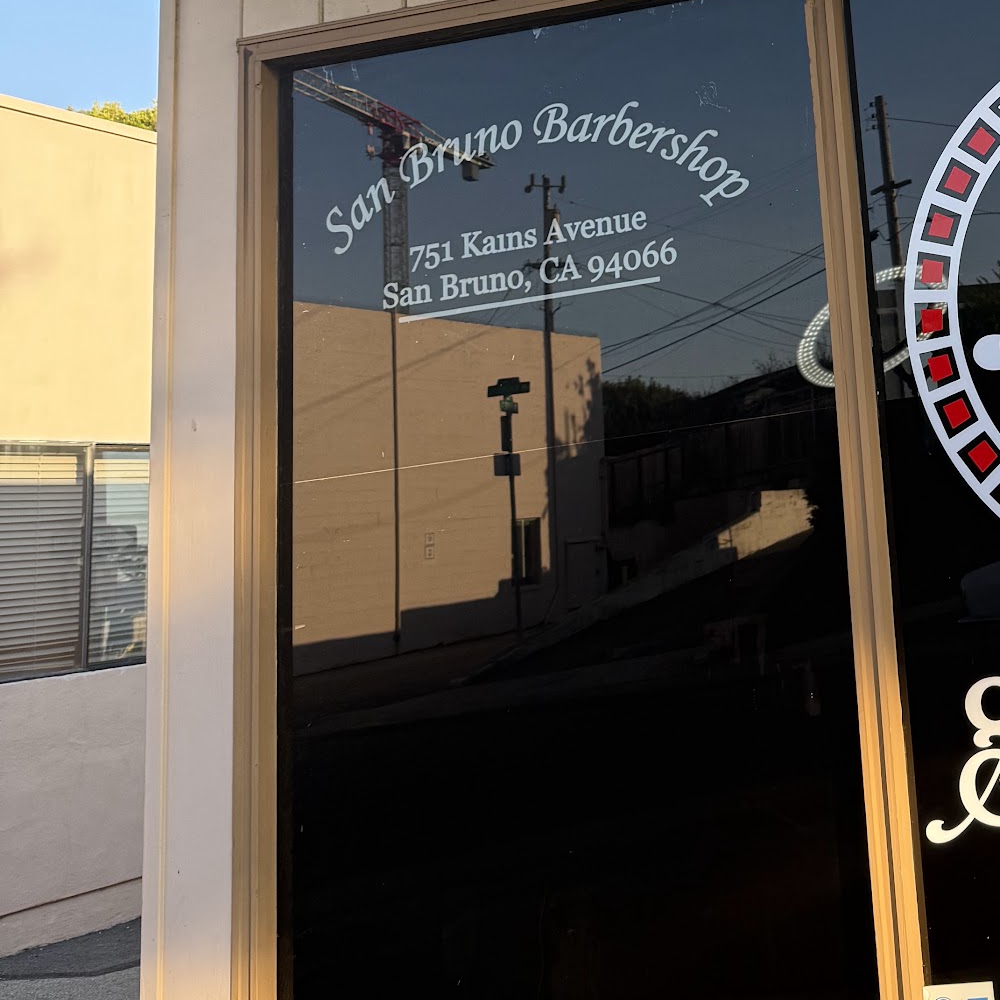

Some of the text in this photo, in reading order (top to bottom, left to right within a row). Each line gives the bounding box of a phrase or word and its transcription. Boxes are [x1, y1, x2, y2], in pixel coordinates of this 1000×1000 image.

[325, 101, 750, 256] San Bruno Barbershop
[382, 237, 678, 310] San Bruno, CA 94066
[409, 240, 454, 273] 751
[543, 210, 648, 245] Avenue
